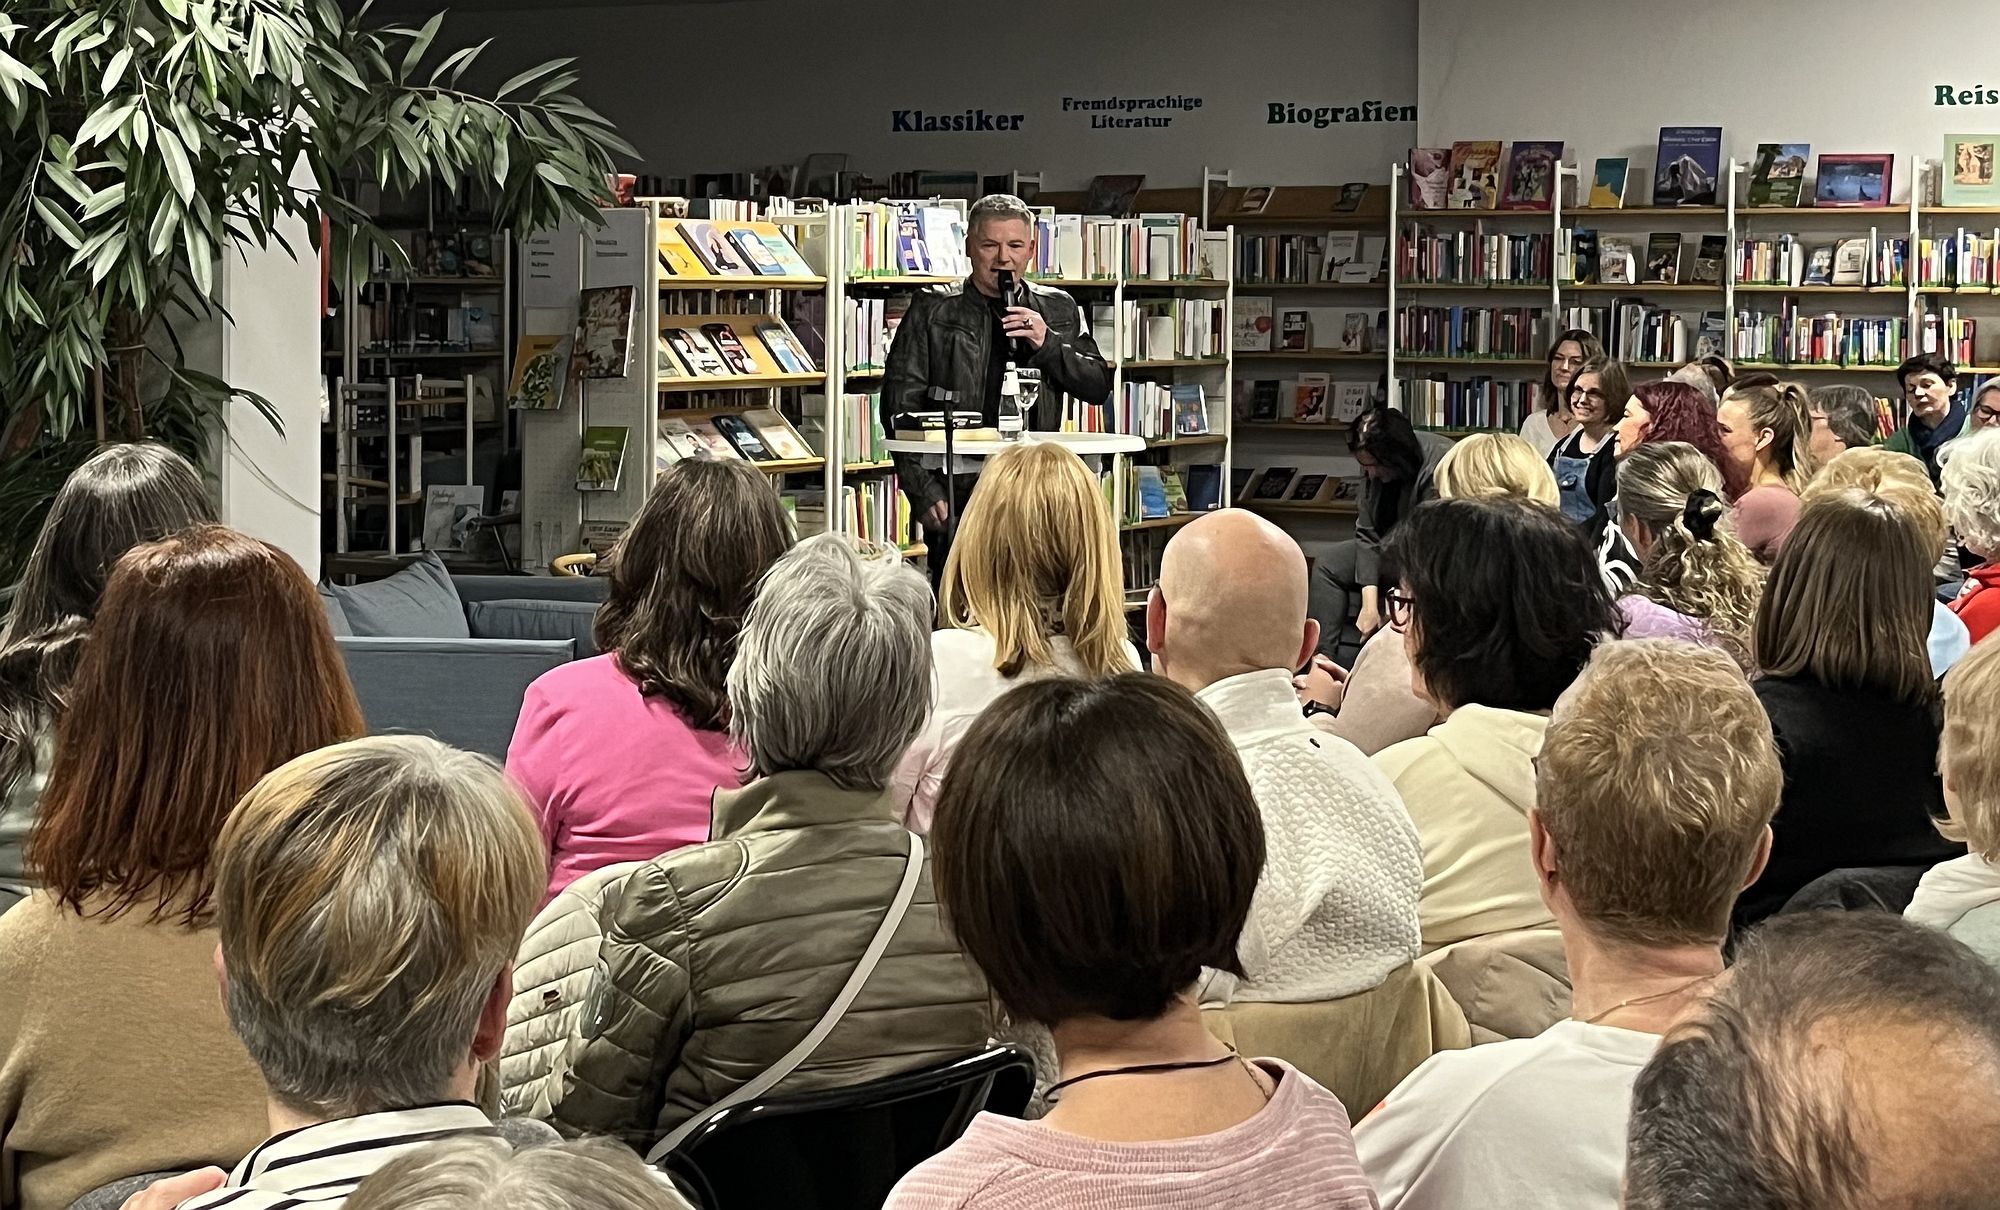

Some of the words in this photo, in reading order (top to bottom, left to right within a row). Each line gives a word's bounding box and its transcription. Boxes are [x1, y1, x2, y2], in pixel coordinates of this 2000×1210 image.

[1062, 95, 1202, 112] Fremdsprachige
[1934, 85, 1998, 105] Reis
[892, 109, 1024, 132] Klassiker
[1091, 115, 1172, 128] Literatur
[1267, 101, 1418, 128] Biografien
